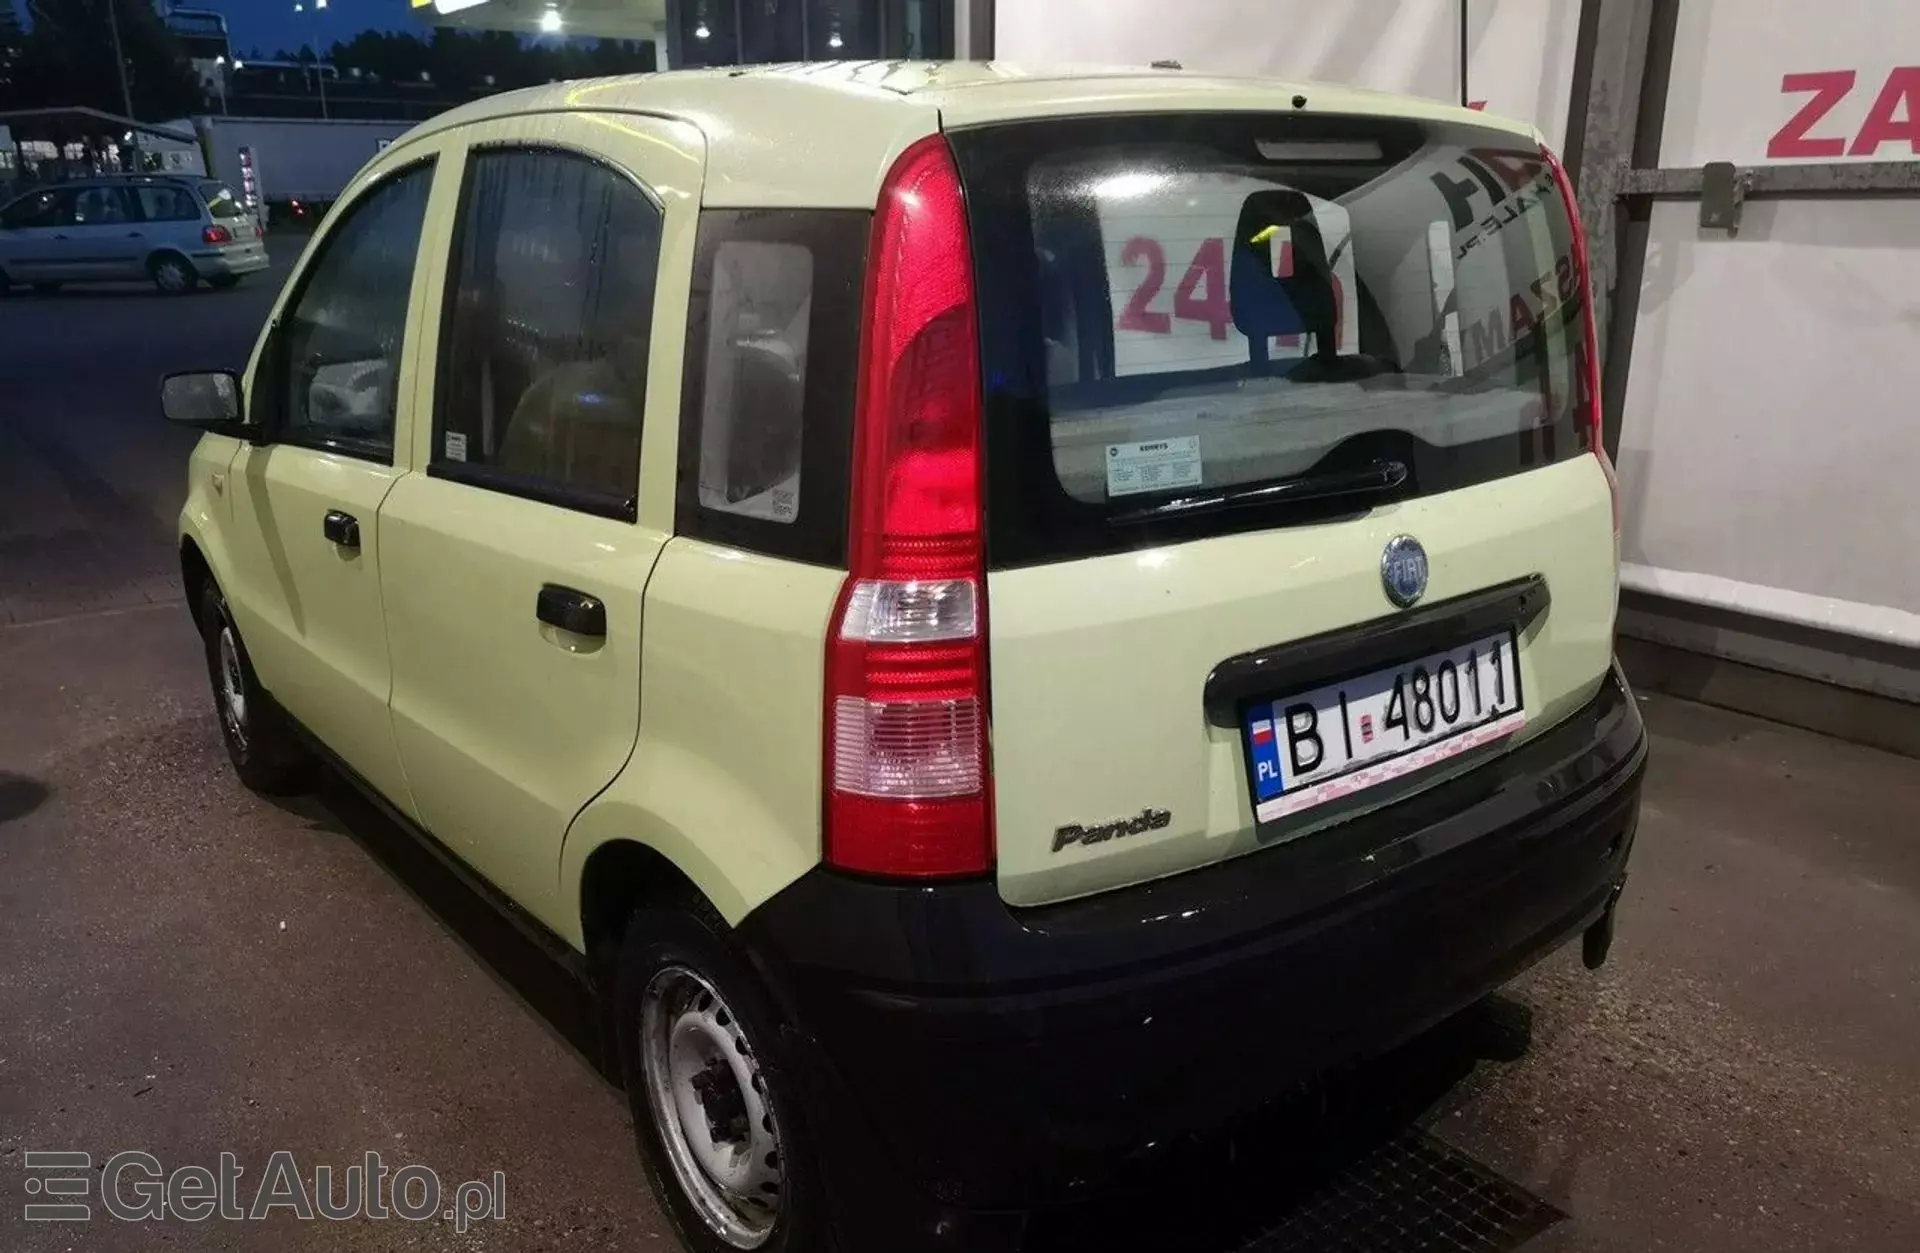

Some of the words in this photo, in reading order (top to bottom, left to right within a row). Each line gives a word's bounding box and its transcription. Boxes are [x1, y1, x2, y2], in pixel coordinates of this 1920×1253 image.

[1767, 66, 1920, 158] ZA
[1392, 556, 1423, 585] FIAT
[1285, 690, 1354, 777] BI
[1383, 639, 1506, 741] 48011
[1257, 761, 1279, 783] PL
[1052, 805, 1172, 852] Panda
